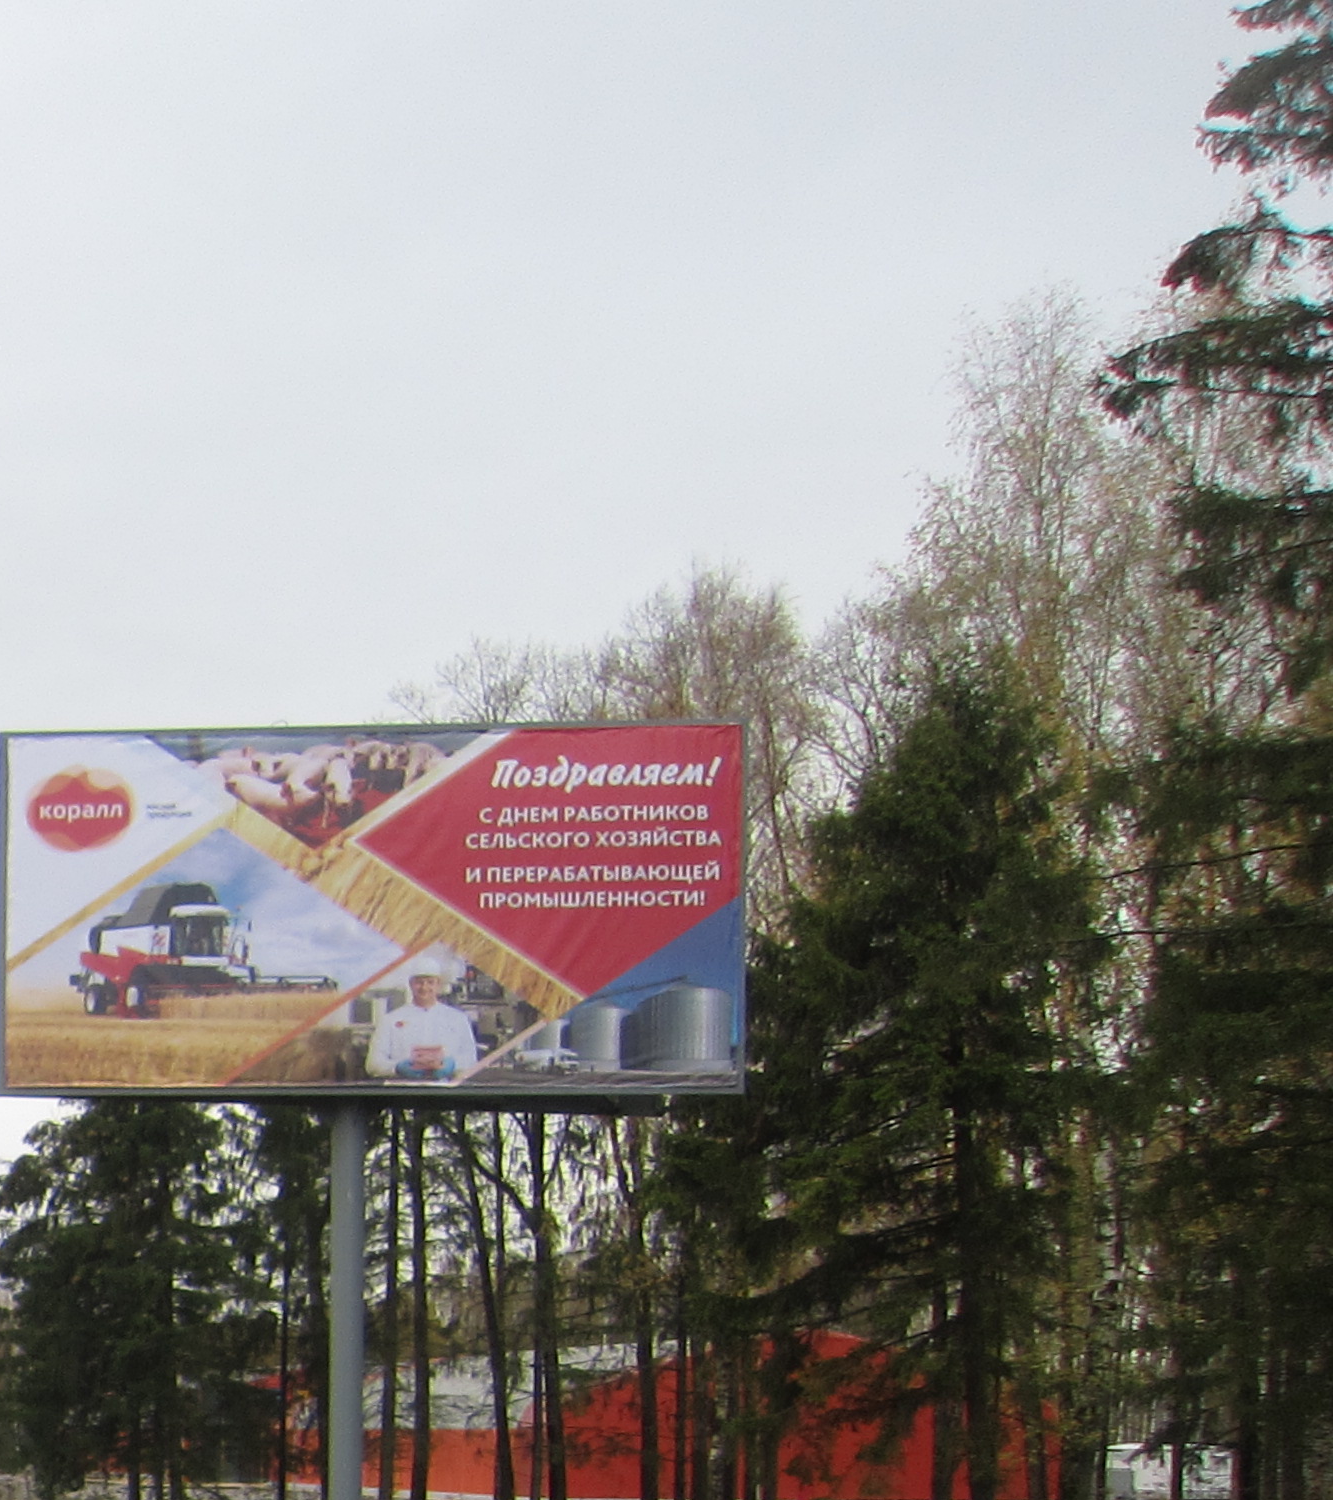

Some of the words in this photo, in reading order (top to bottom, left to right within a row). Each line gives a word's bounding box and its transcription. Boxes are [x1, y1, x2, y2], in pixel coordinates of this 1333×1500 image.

[490, 755, 722, 794] Поздравляем!
[39, 803, 123, 823] коралл
[478, 807, 493, 824] С
[497, 807, 558, 827] ДНЕМ
[563, 805, 709, 823] РАБОТНИКОВ
[465, 831, 590, 849] СЕЛЬСКОГО
[595, 827, 722, 847] ХОЗЯЙСТВА
[465, 867, 482, 884] И
[487, 861, 721, 884] ПЕРЕРАБАТЫВАЮЩЕЙ
[479, 890, 706, 909] ПРОМЫШЛЕННОСТИ!
